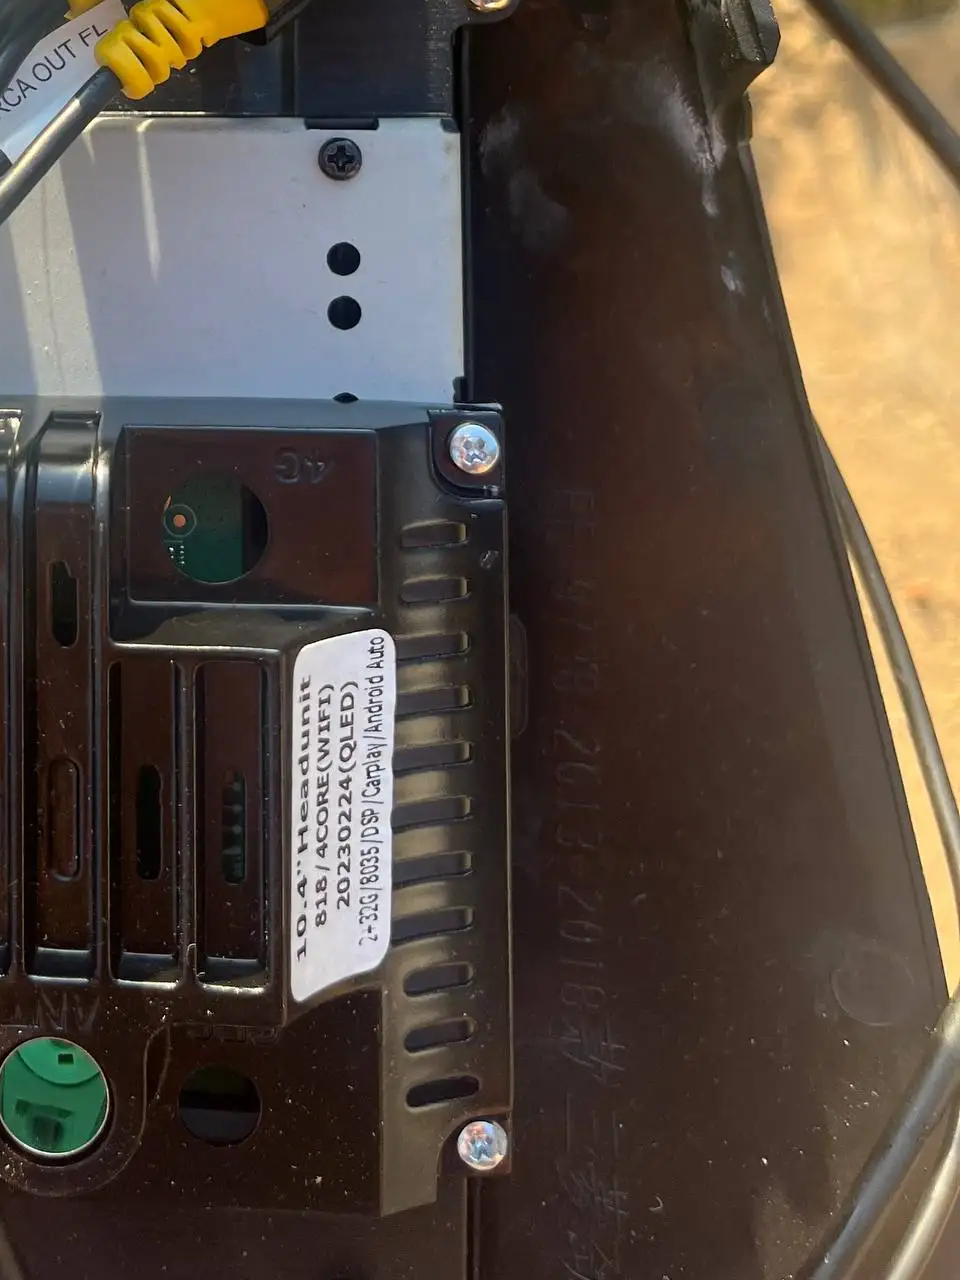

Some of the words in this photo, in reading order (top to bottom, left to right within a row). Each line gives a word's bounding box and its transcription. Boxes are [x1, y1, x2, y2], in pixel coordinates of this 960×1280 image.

[32, 38, 77, 82] OUT
[78, 24, 109, 47] FL
[366, 636, 385, 670] Auto
[315, 683, 335, 927] 818/4CORE(WIFI)
[336, 680, 358, 910] 20230224(QLED)
